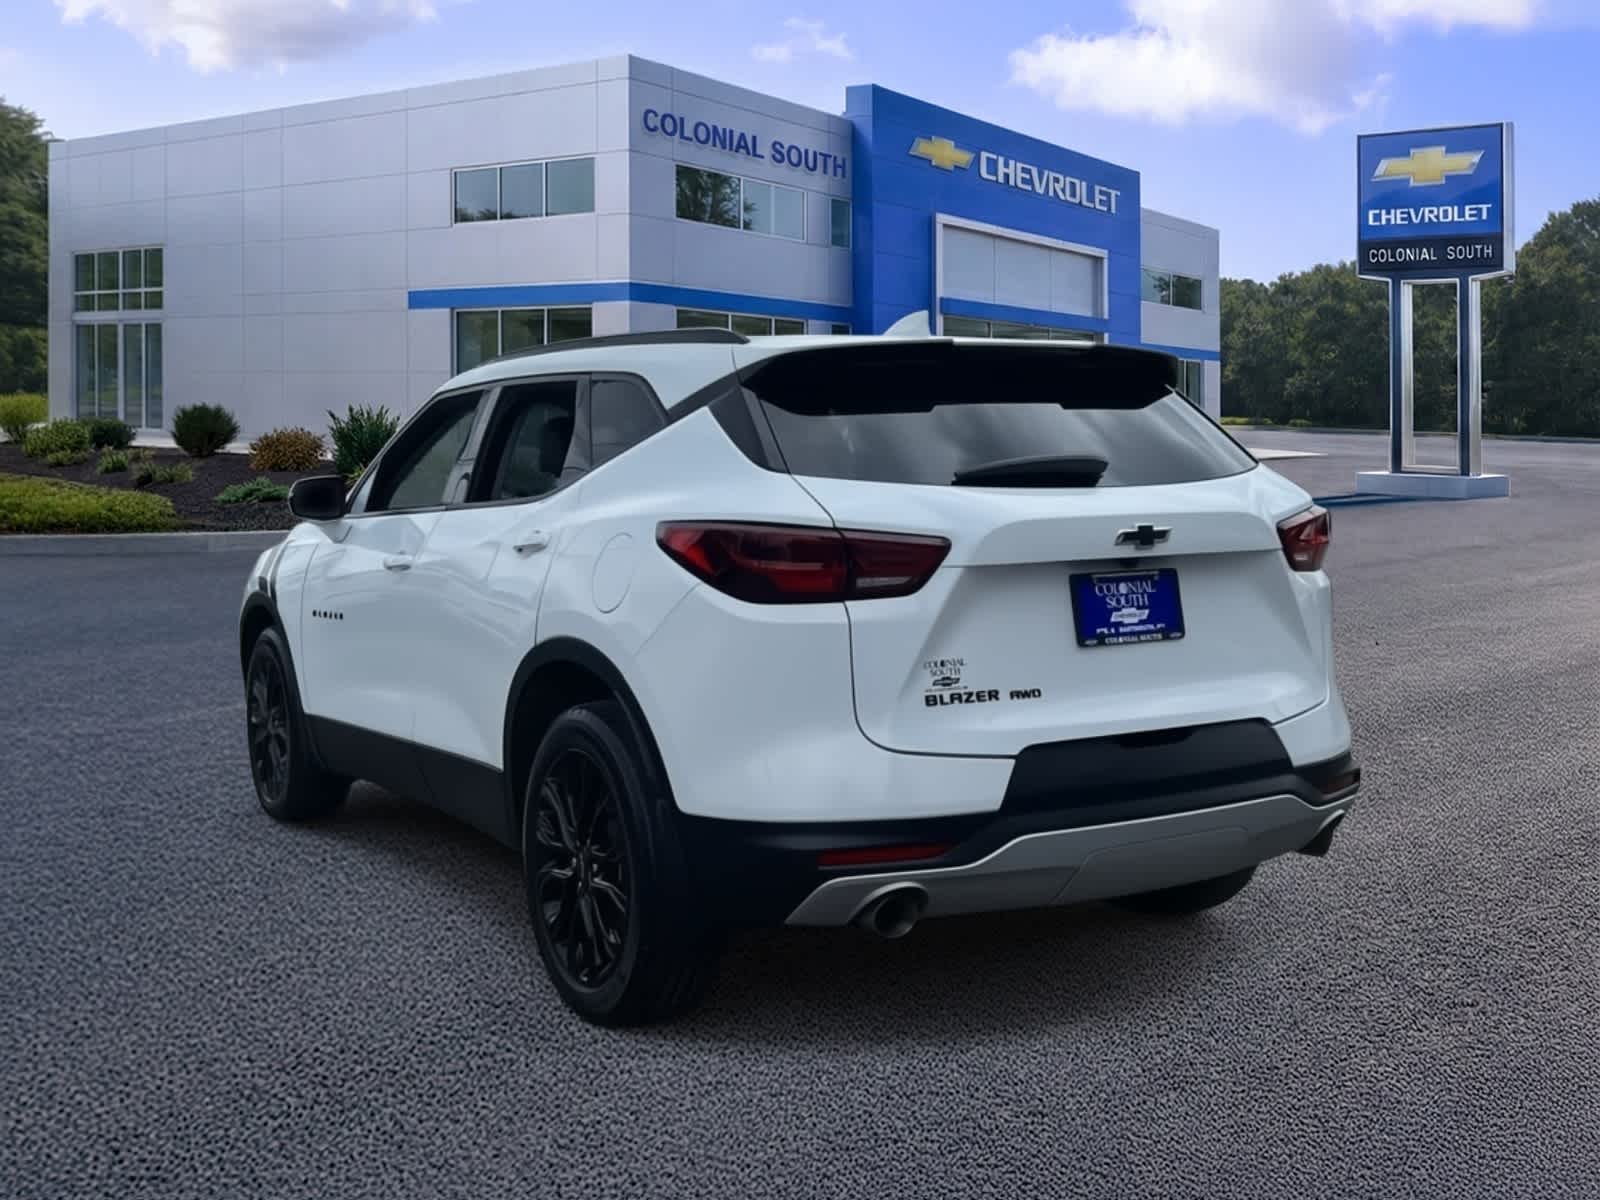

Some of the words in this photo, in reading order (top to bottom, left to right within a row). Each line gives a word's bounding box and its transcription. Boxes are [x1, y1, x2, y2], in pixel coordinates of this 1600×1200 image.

[643, 109, 765, 159] COLONIAL
[771, 140, 847, 179] SOUTH
[979, 150, 1120, 214] CHEVROLET
[1368, 204, 1492, 226] CHEVROLET
[1369, 248, 1437, 263] COLONIAL
[1447, 244, 1493, 260] SOUTH
[1096, 581, 1157, 596] COLONIAL
[1106, 593, 1149, 608] SOUTH
[924, 689, 1000, 708] BLAZER
[1009, 688, 1042, 701] AWD
